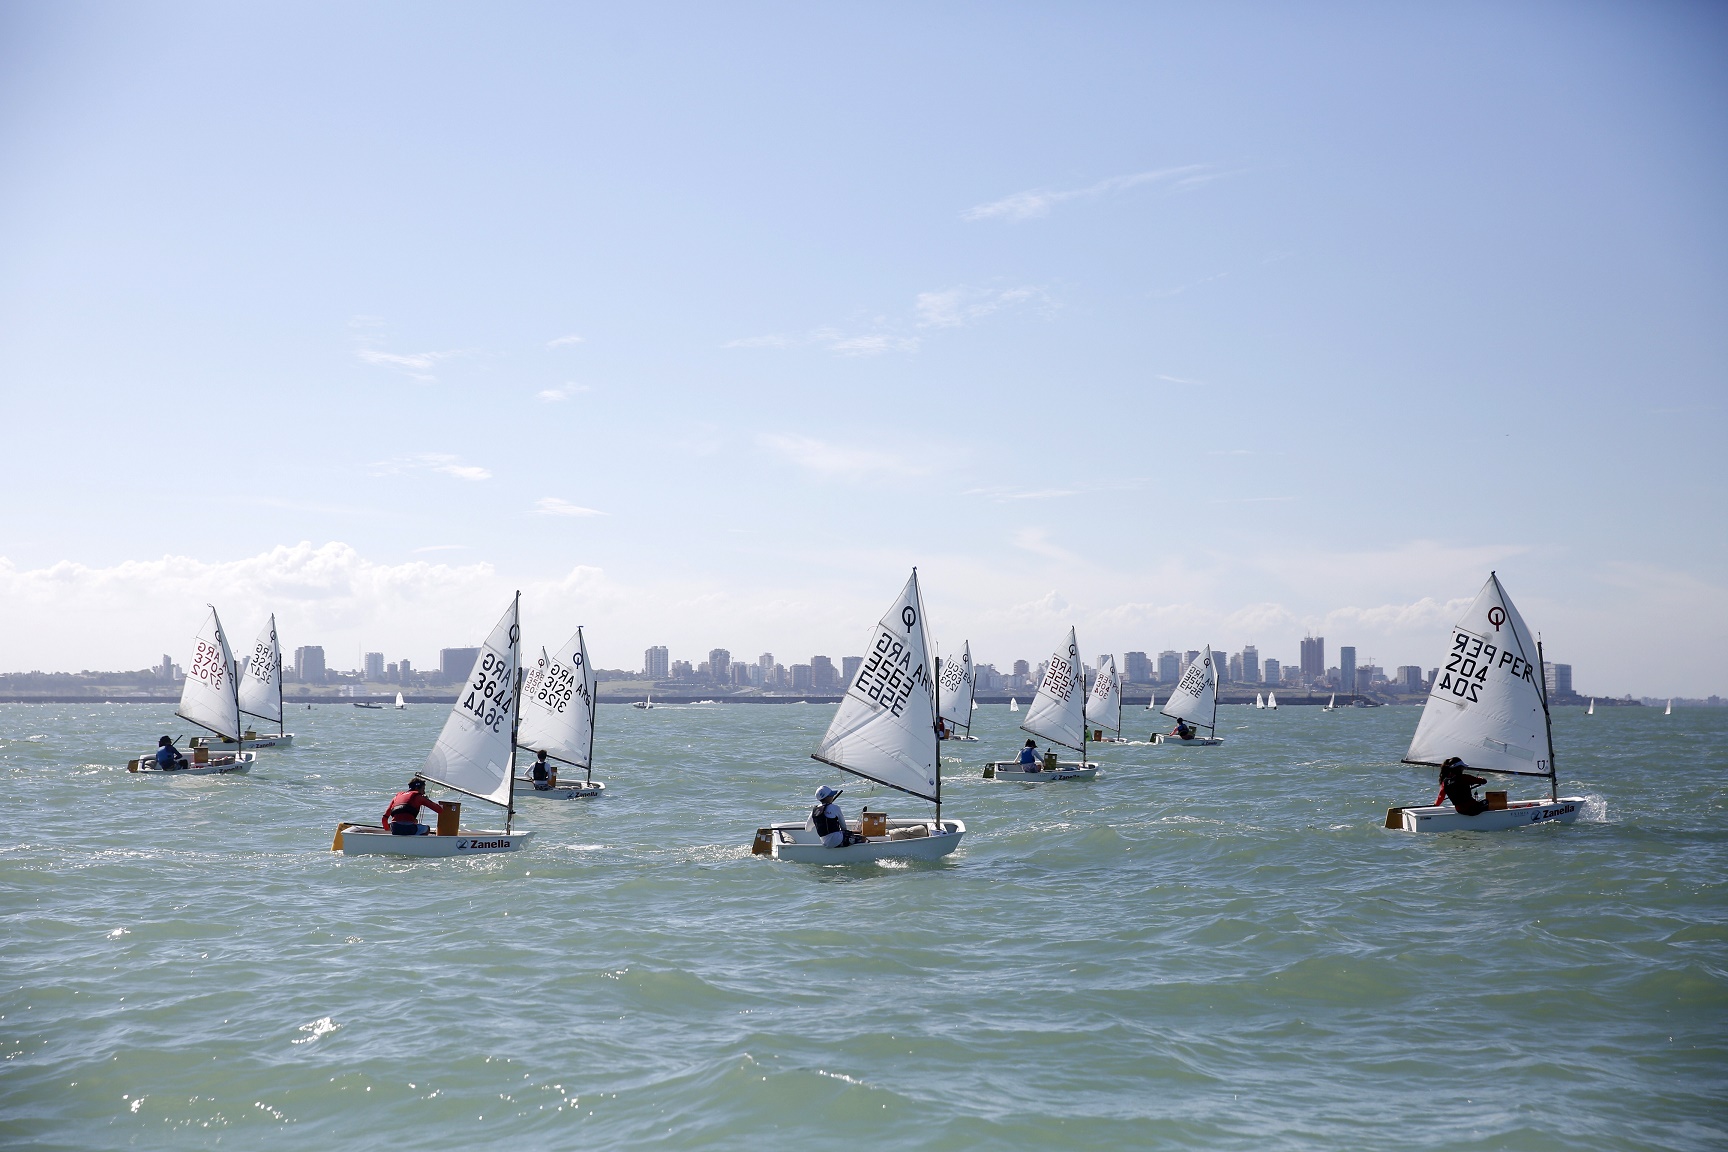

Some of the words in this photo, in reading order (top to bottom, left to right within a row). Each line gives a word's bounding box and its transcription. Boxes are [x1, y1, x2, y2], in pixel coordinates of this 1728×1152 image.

[194, 653, 224, 679] 3702
[252, 653, 276, 673] 3247
[864, 651, 915, 698] 3563
[1445, 653, 1488, 683] 204
[1498, 651, 1533, 683] PER
[544, 676, 573, 701] 3126
[943, 668, 962, 685] 1203
[1046, 668, 1076, 692] 3254
[1096, 681, 1110, 692] 304
[1184, 673, 1206, 692] 3543
[472, 672, 513, 714] 3644
[1542, 805, 1575, 819] Zanella
[470, 840, 511, 849] Zanella
